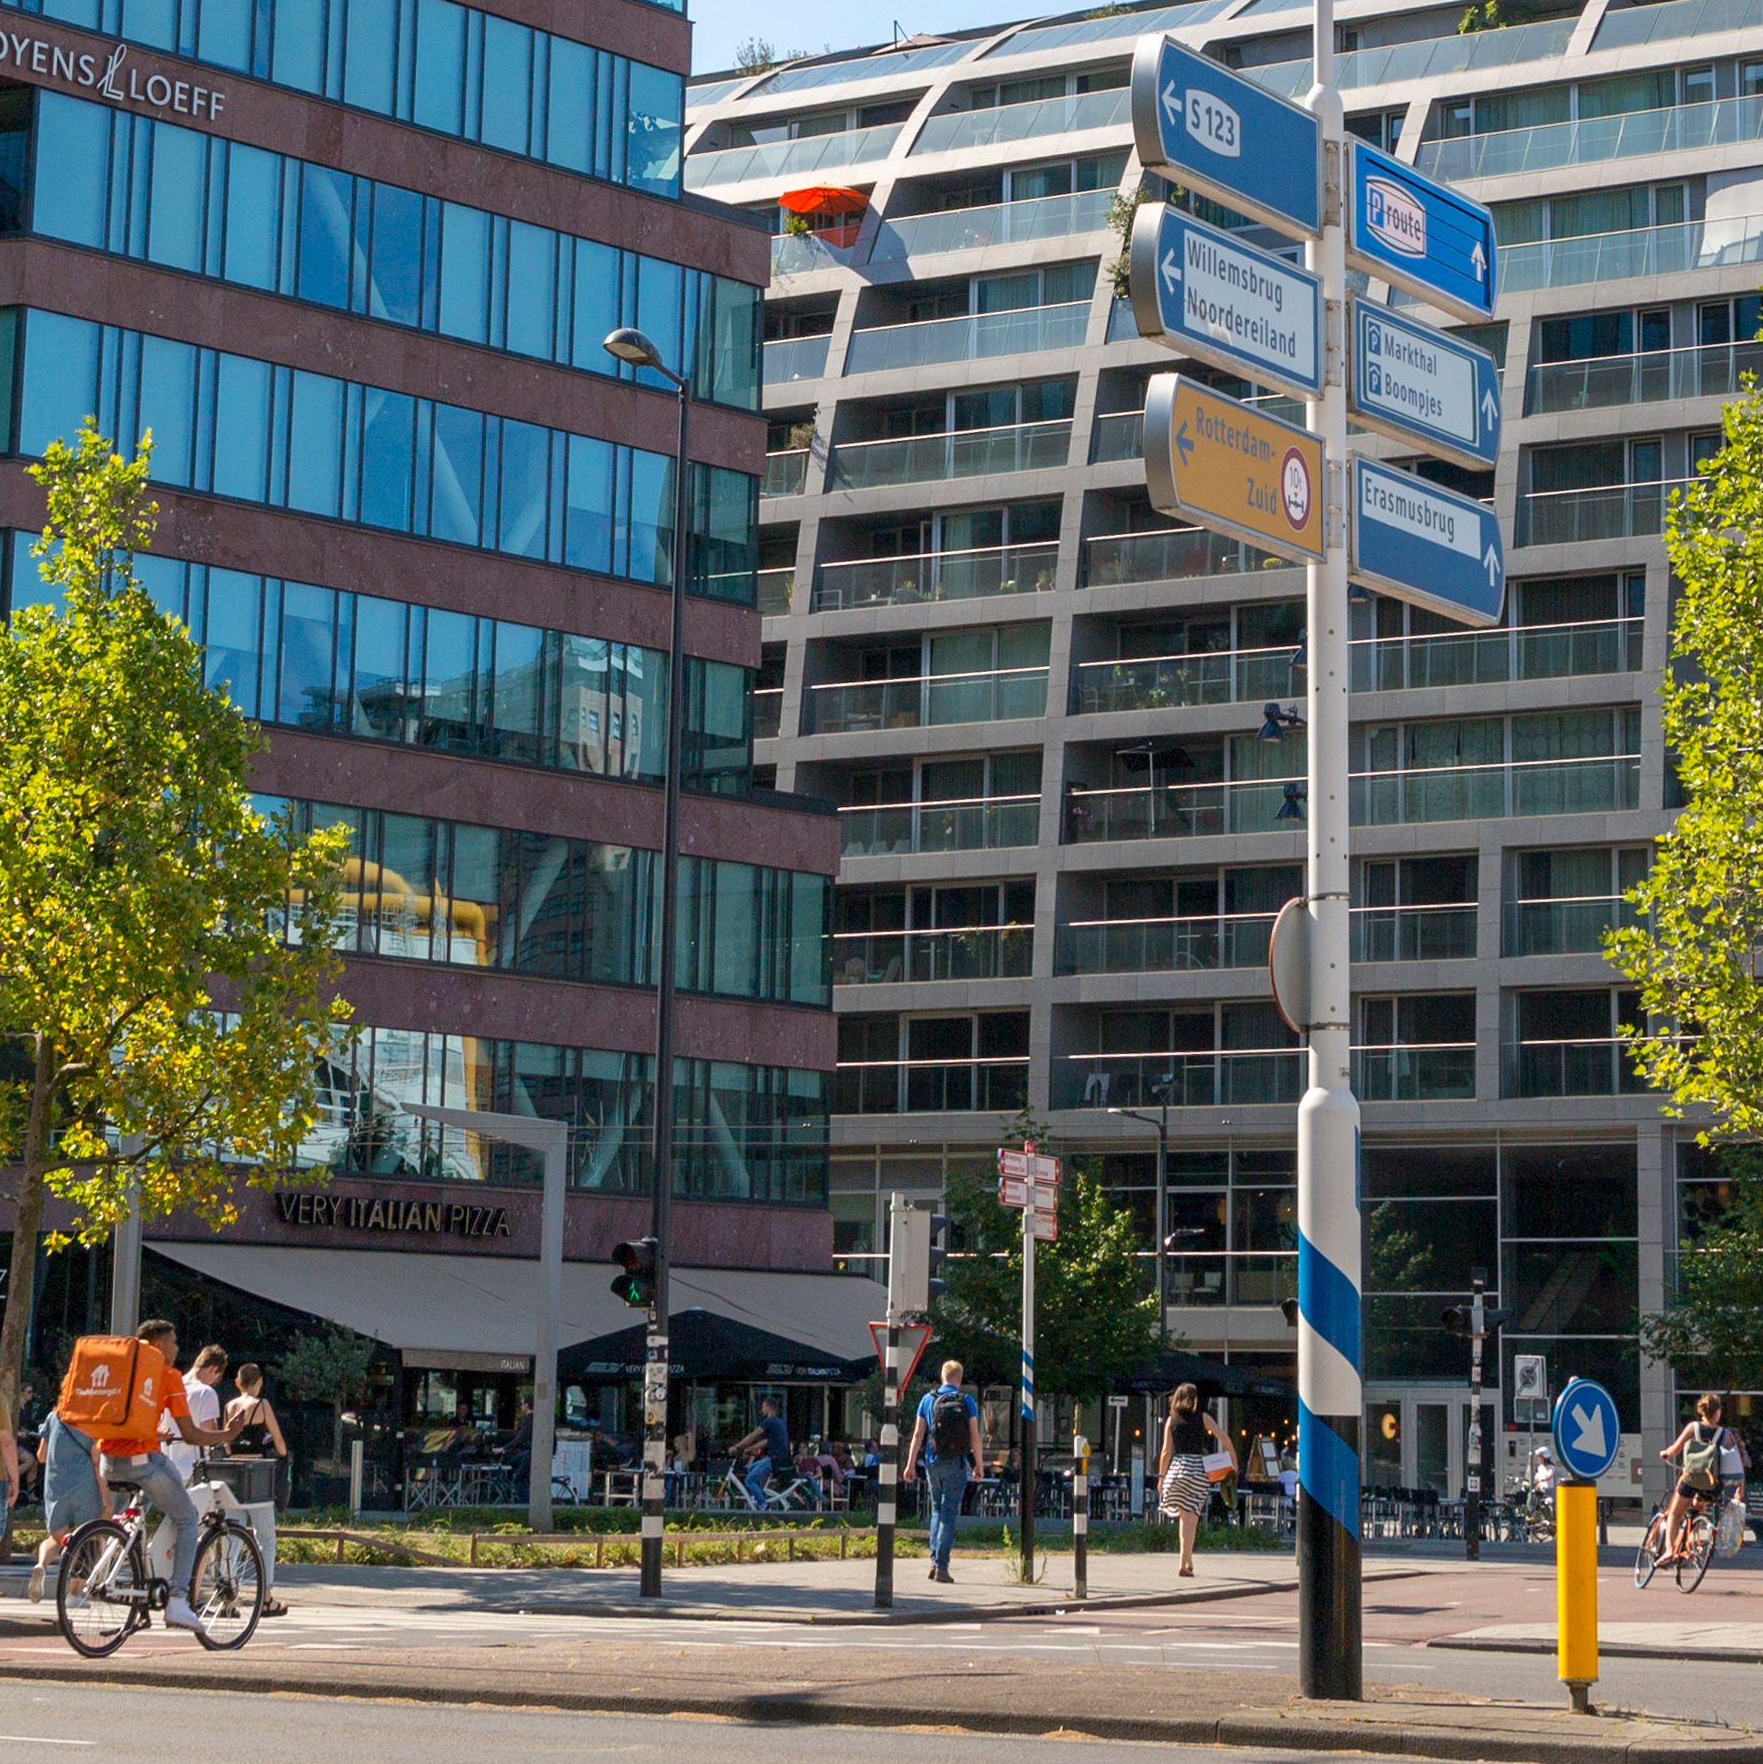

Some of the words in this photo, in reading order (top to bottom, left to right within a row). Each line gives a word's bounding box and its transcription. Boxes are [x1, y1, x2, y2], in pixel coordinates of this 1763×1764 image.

[130, 69, 226, 121] LOEFF
[1190, 97, 1201, 130] S
[1204, 104, 1235, 147] 123
[1386, 207, 1422, 242] route
[1186, 237, 1283, 313] Willemsbrug
[1187, 285, 1297, 359] Noordereiland
[1384, 332, 1437, 376] Markthal
[1385, 372, 1443, 418] Boompjes
[1195, 405, 1277, 461] Rotterdam-
[1246, 478, 1278, 516] Zuid
[1364, 476, 1455, 544] Erasmusbrug
[280, 1193, 342, 1226] VERY
[349, 1197, 443, 1233] ITALIAN
[449, 1204, 512, 1237] PIZZA
[501, 1359, 525, 1370] ITALIAN
